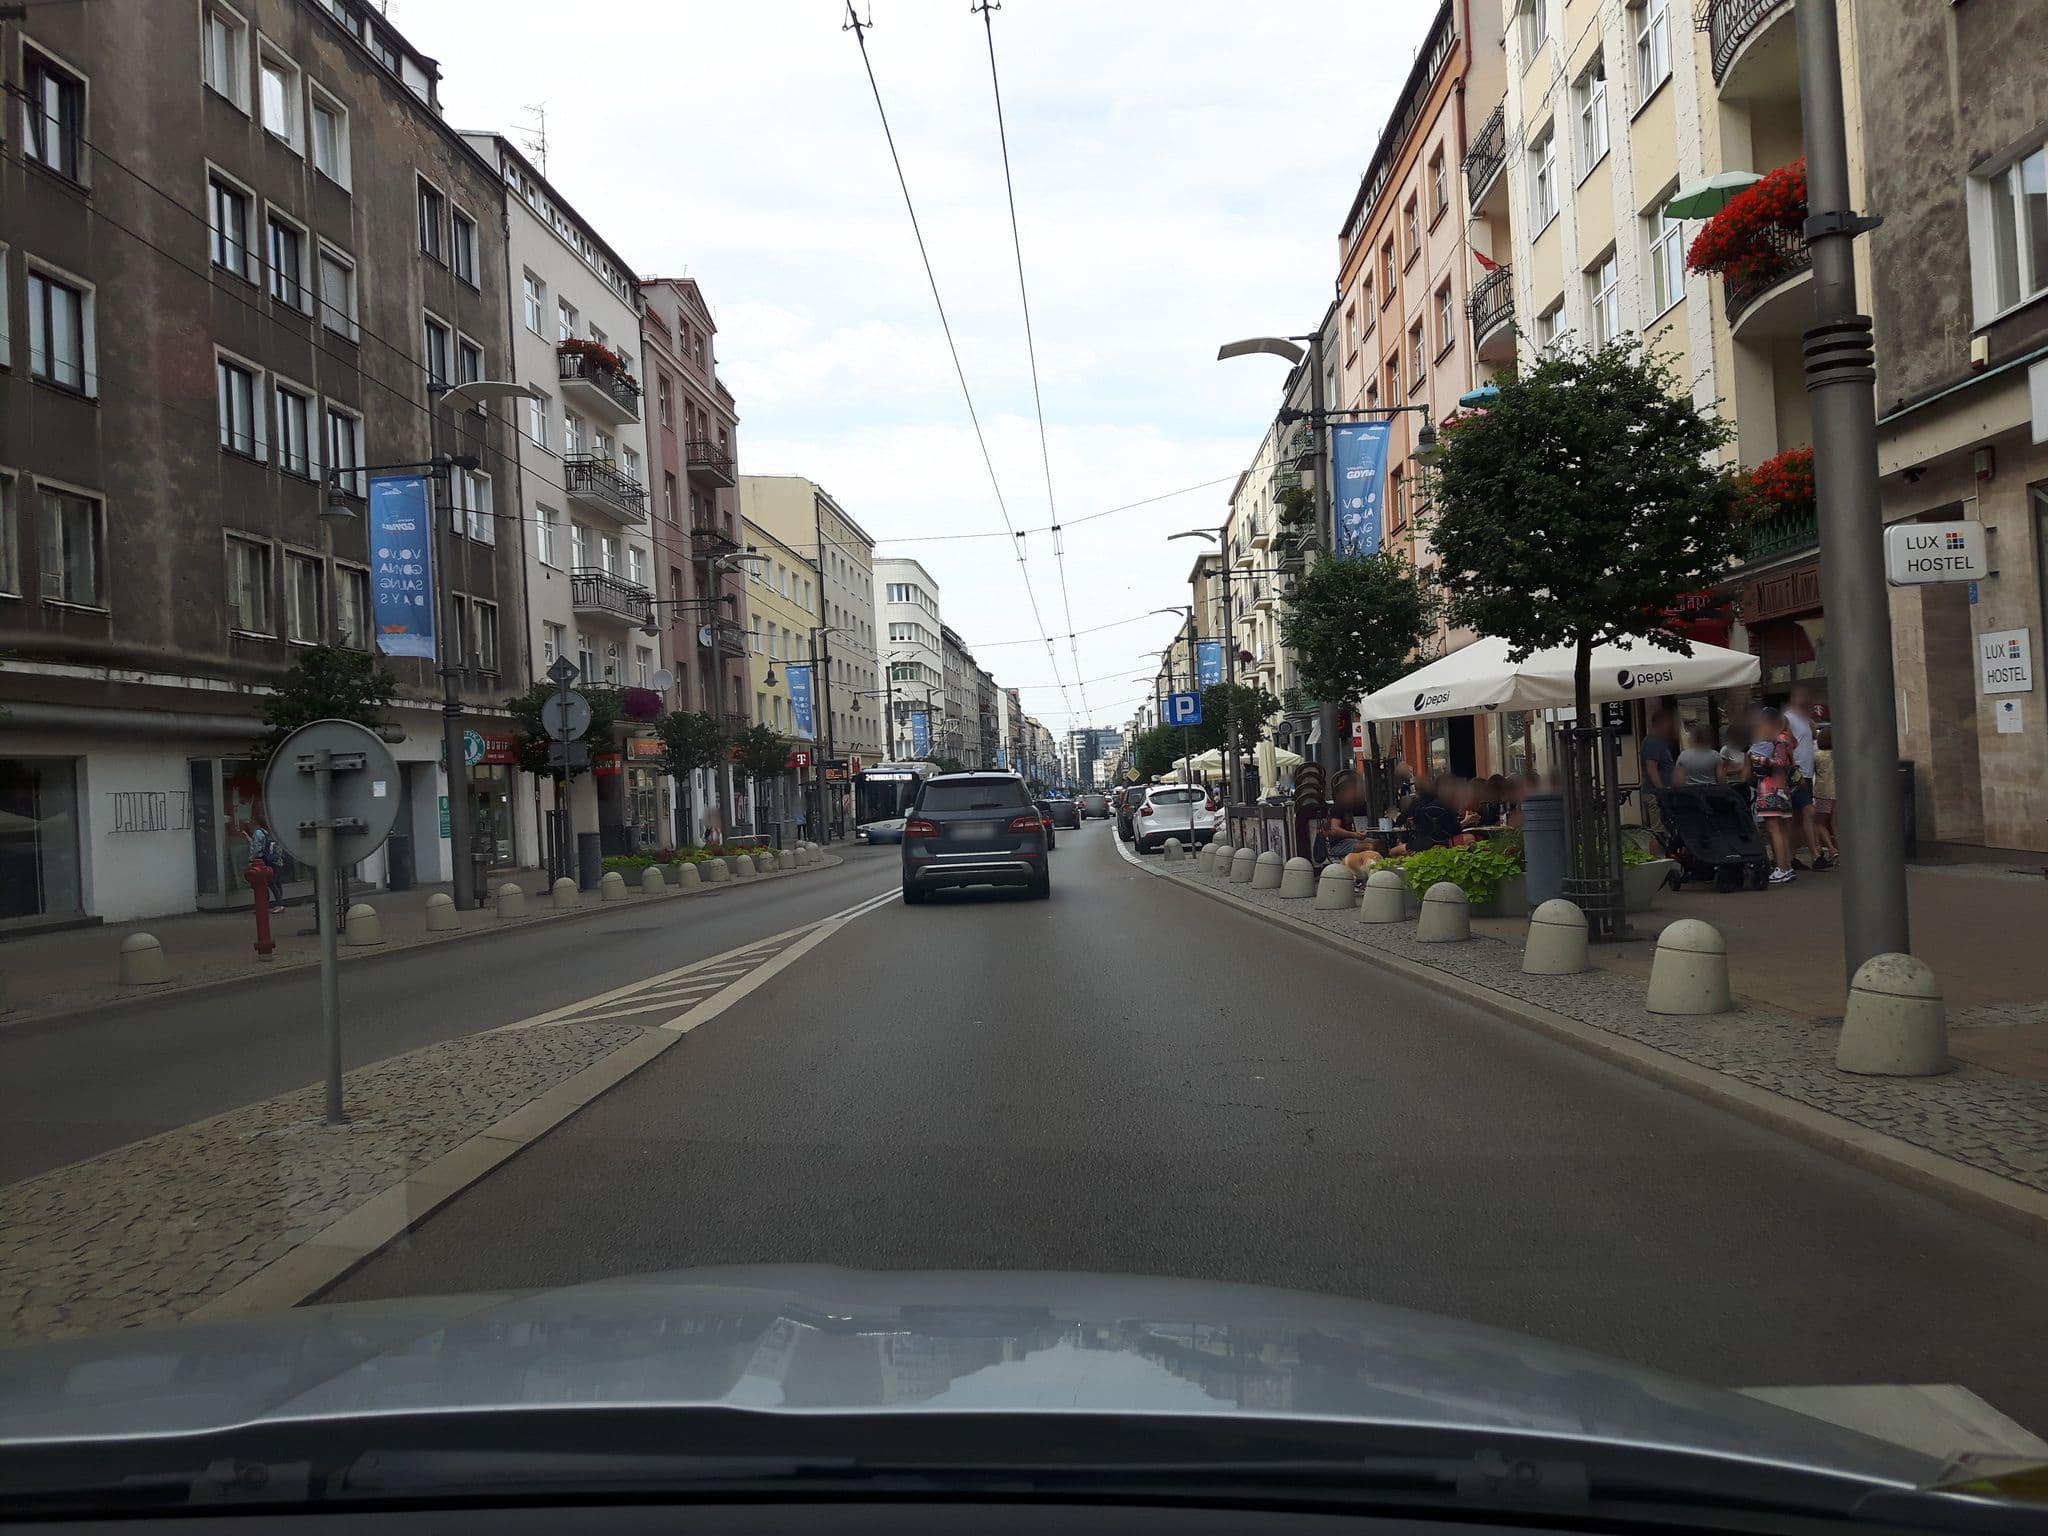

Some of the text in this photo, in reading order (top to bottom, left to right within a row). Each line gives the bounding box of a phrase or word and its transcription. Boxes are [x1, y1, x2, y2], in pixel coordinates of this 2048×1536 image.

[1906, 535, 1940, 550] LUX
[1907, 556, 1975, 573] HOSTEL
[1985, 644, 2005, 660] LUX
[1637, 669, 1673, 686] pepsi
[1987, 667, 2028, 684] HOSTEL
[1425, 690, 1451, 708] pepsi
[1175, 696, 1194, 722] P
[796, 753, 806, 765] T
